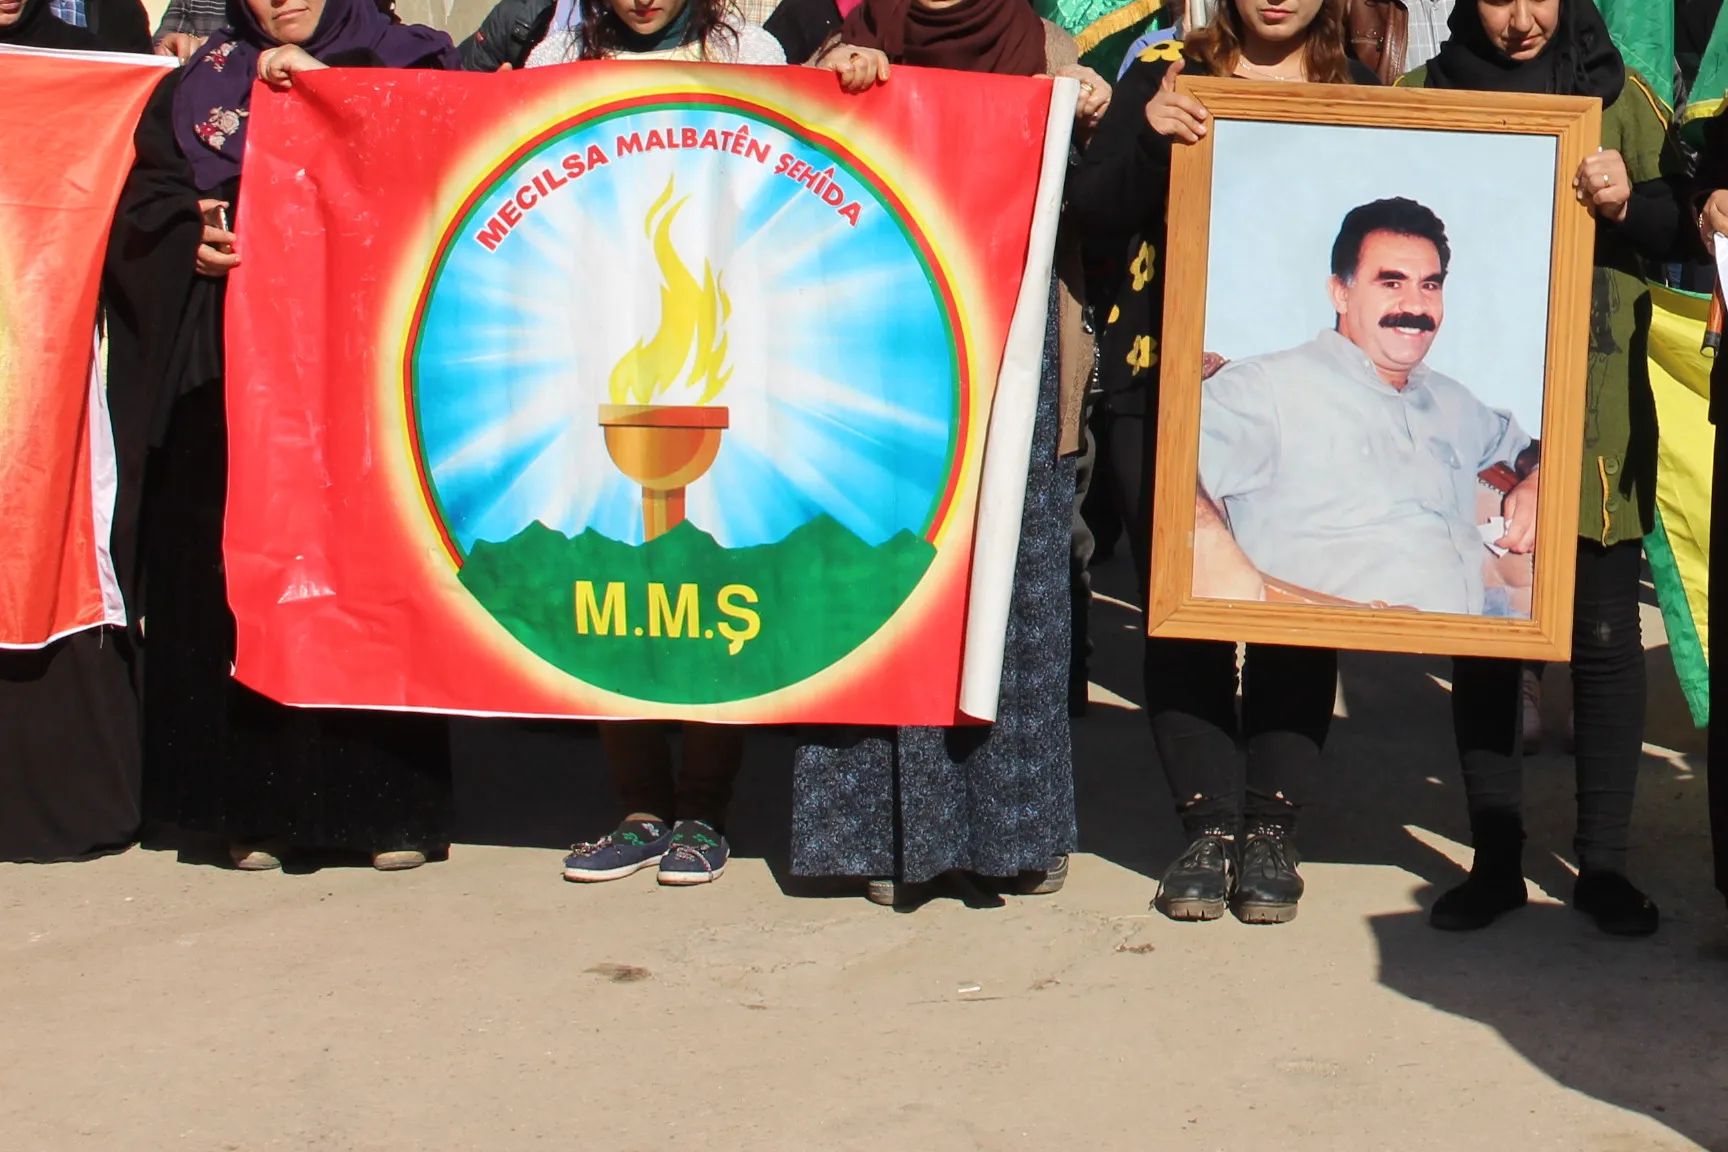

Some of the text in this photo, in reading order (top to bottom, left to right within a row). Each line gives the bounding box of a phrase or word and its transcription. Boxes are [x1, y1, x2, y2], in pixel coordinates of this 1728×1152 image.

[475, 123, 863, 252] MECILSA MALBATÊN ŞEHÎDA
[575, 580, 761, 656] M.M.Ş
